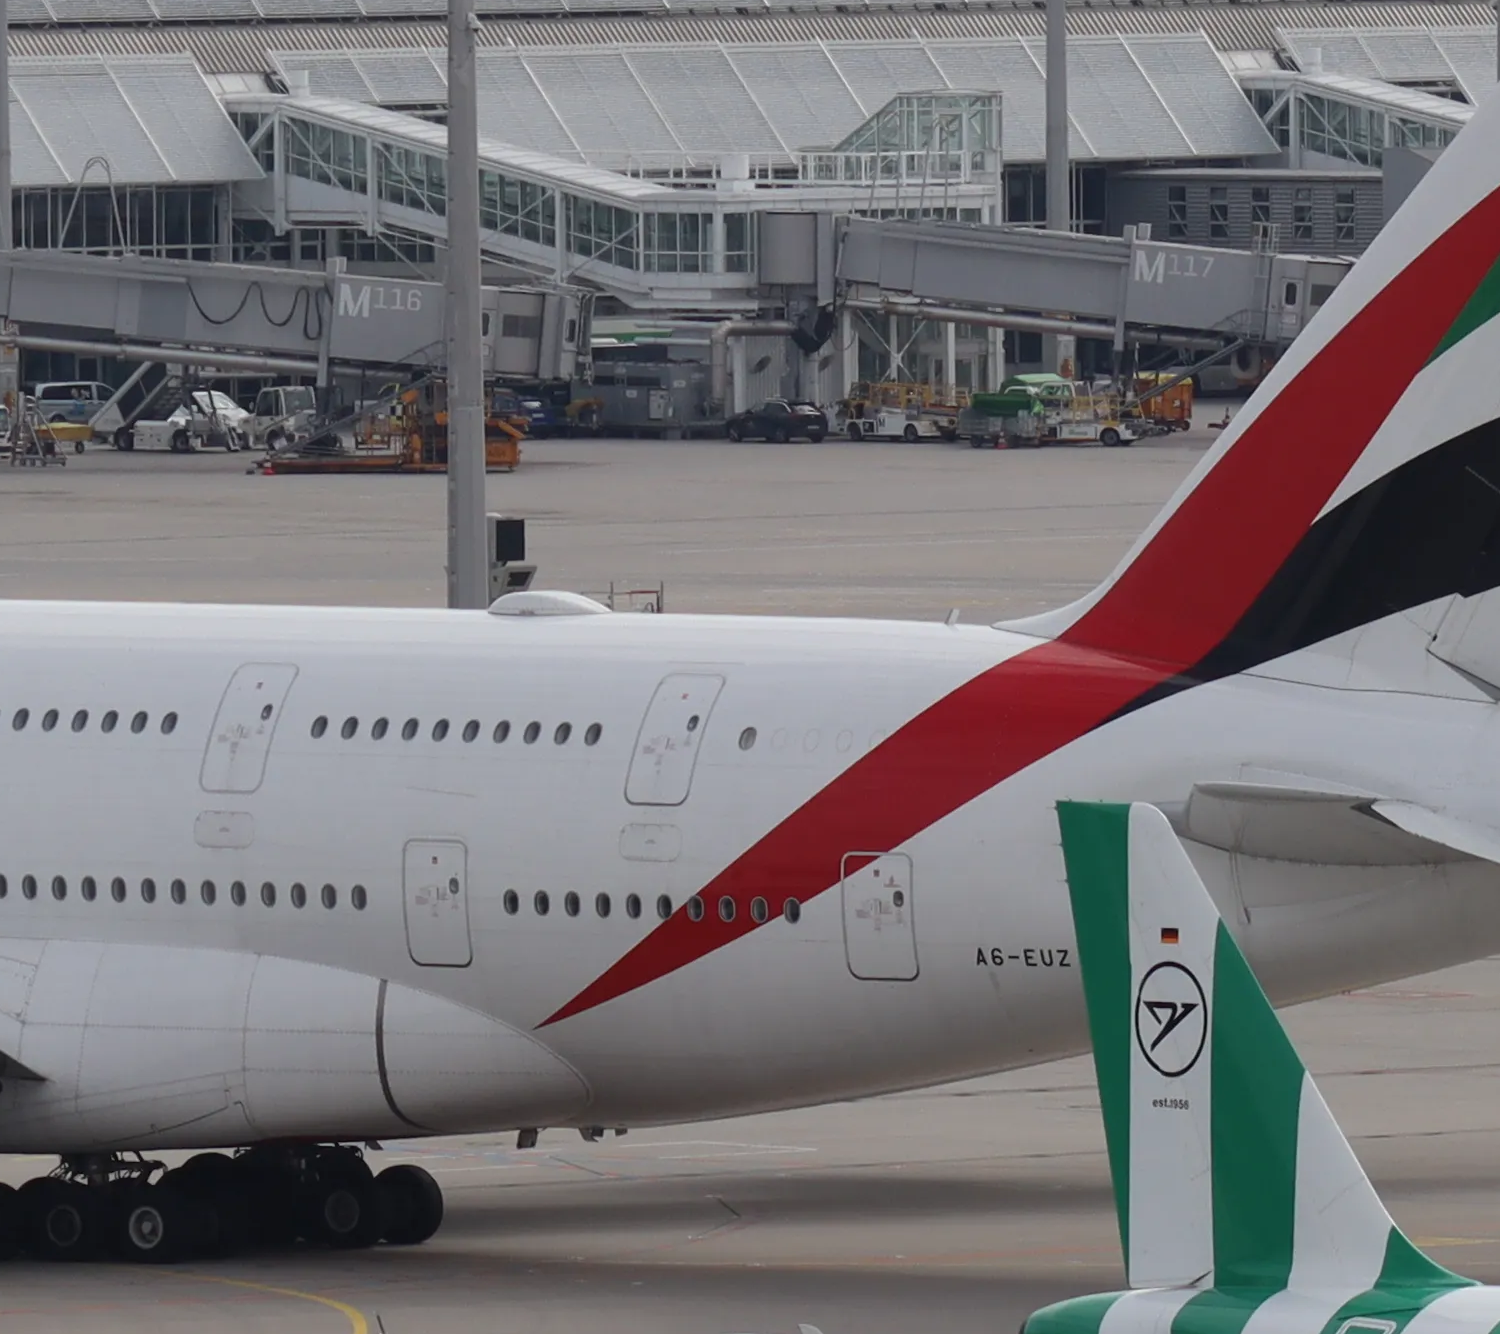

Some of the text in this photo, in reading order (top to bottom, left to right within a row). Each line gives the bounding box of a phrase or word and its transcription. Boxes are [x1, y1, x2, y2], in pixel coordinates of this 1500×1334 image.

[1134, 250, 1215, 284] M117
[338, 283, 422, 318] M116
[976, 947, 1071, 967] A6-EUZ
